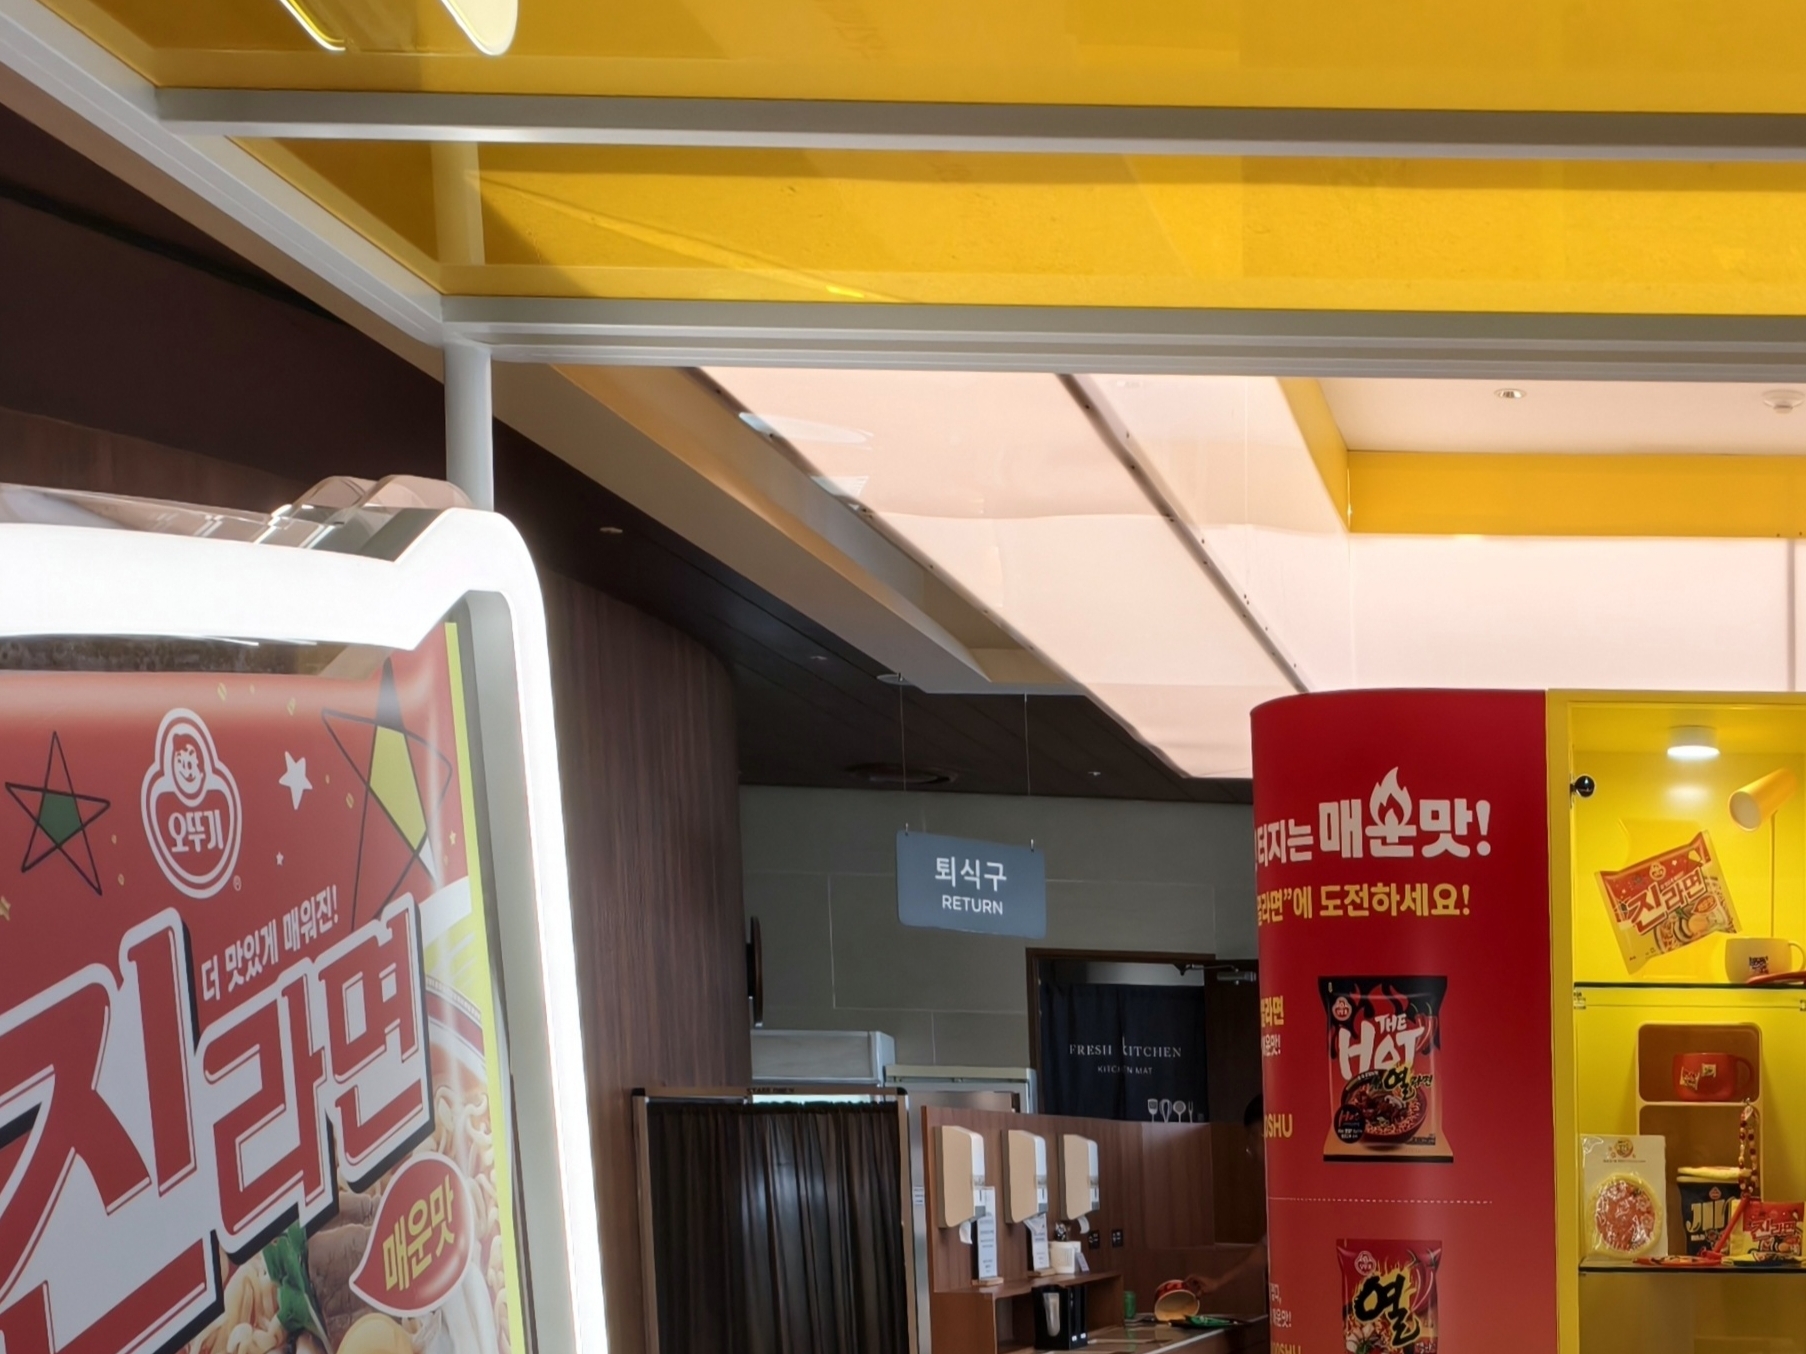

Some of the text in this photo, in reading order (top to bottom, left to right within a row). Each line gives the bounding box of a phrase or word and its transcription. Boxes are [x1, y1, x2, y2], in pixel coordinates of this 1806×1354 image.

[168, 809, 225, 854] 오뚜기
[1319, 776, 1491, 859] 매운맛!
[934, 856, 1008, 892] 퇴식구
[941, 894, 1004, 916] RETURN
[1319, 883, 1471, 917] 도전하세요!
[1625, 866, 1707, 936] 진라면
[201, 884, 340, 1002] 더 맛있게 매워진!
[1374, 1013, 1407, 1033] THE
[1069, 1043, 1113, 1056] FRESH
[1135, 1066, 1153, 1075] MAT
[1338, 1020, 1425, 1080] HOT
[382, 1175, 456, 1292] 매운맛
[1354, 1273, 1421, 1347] 열
